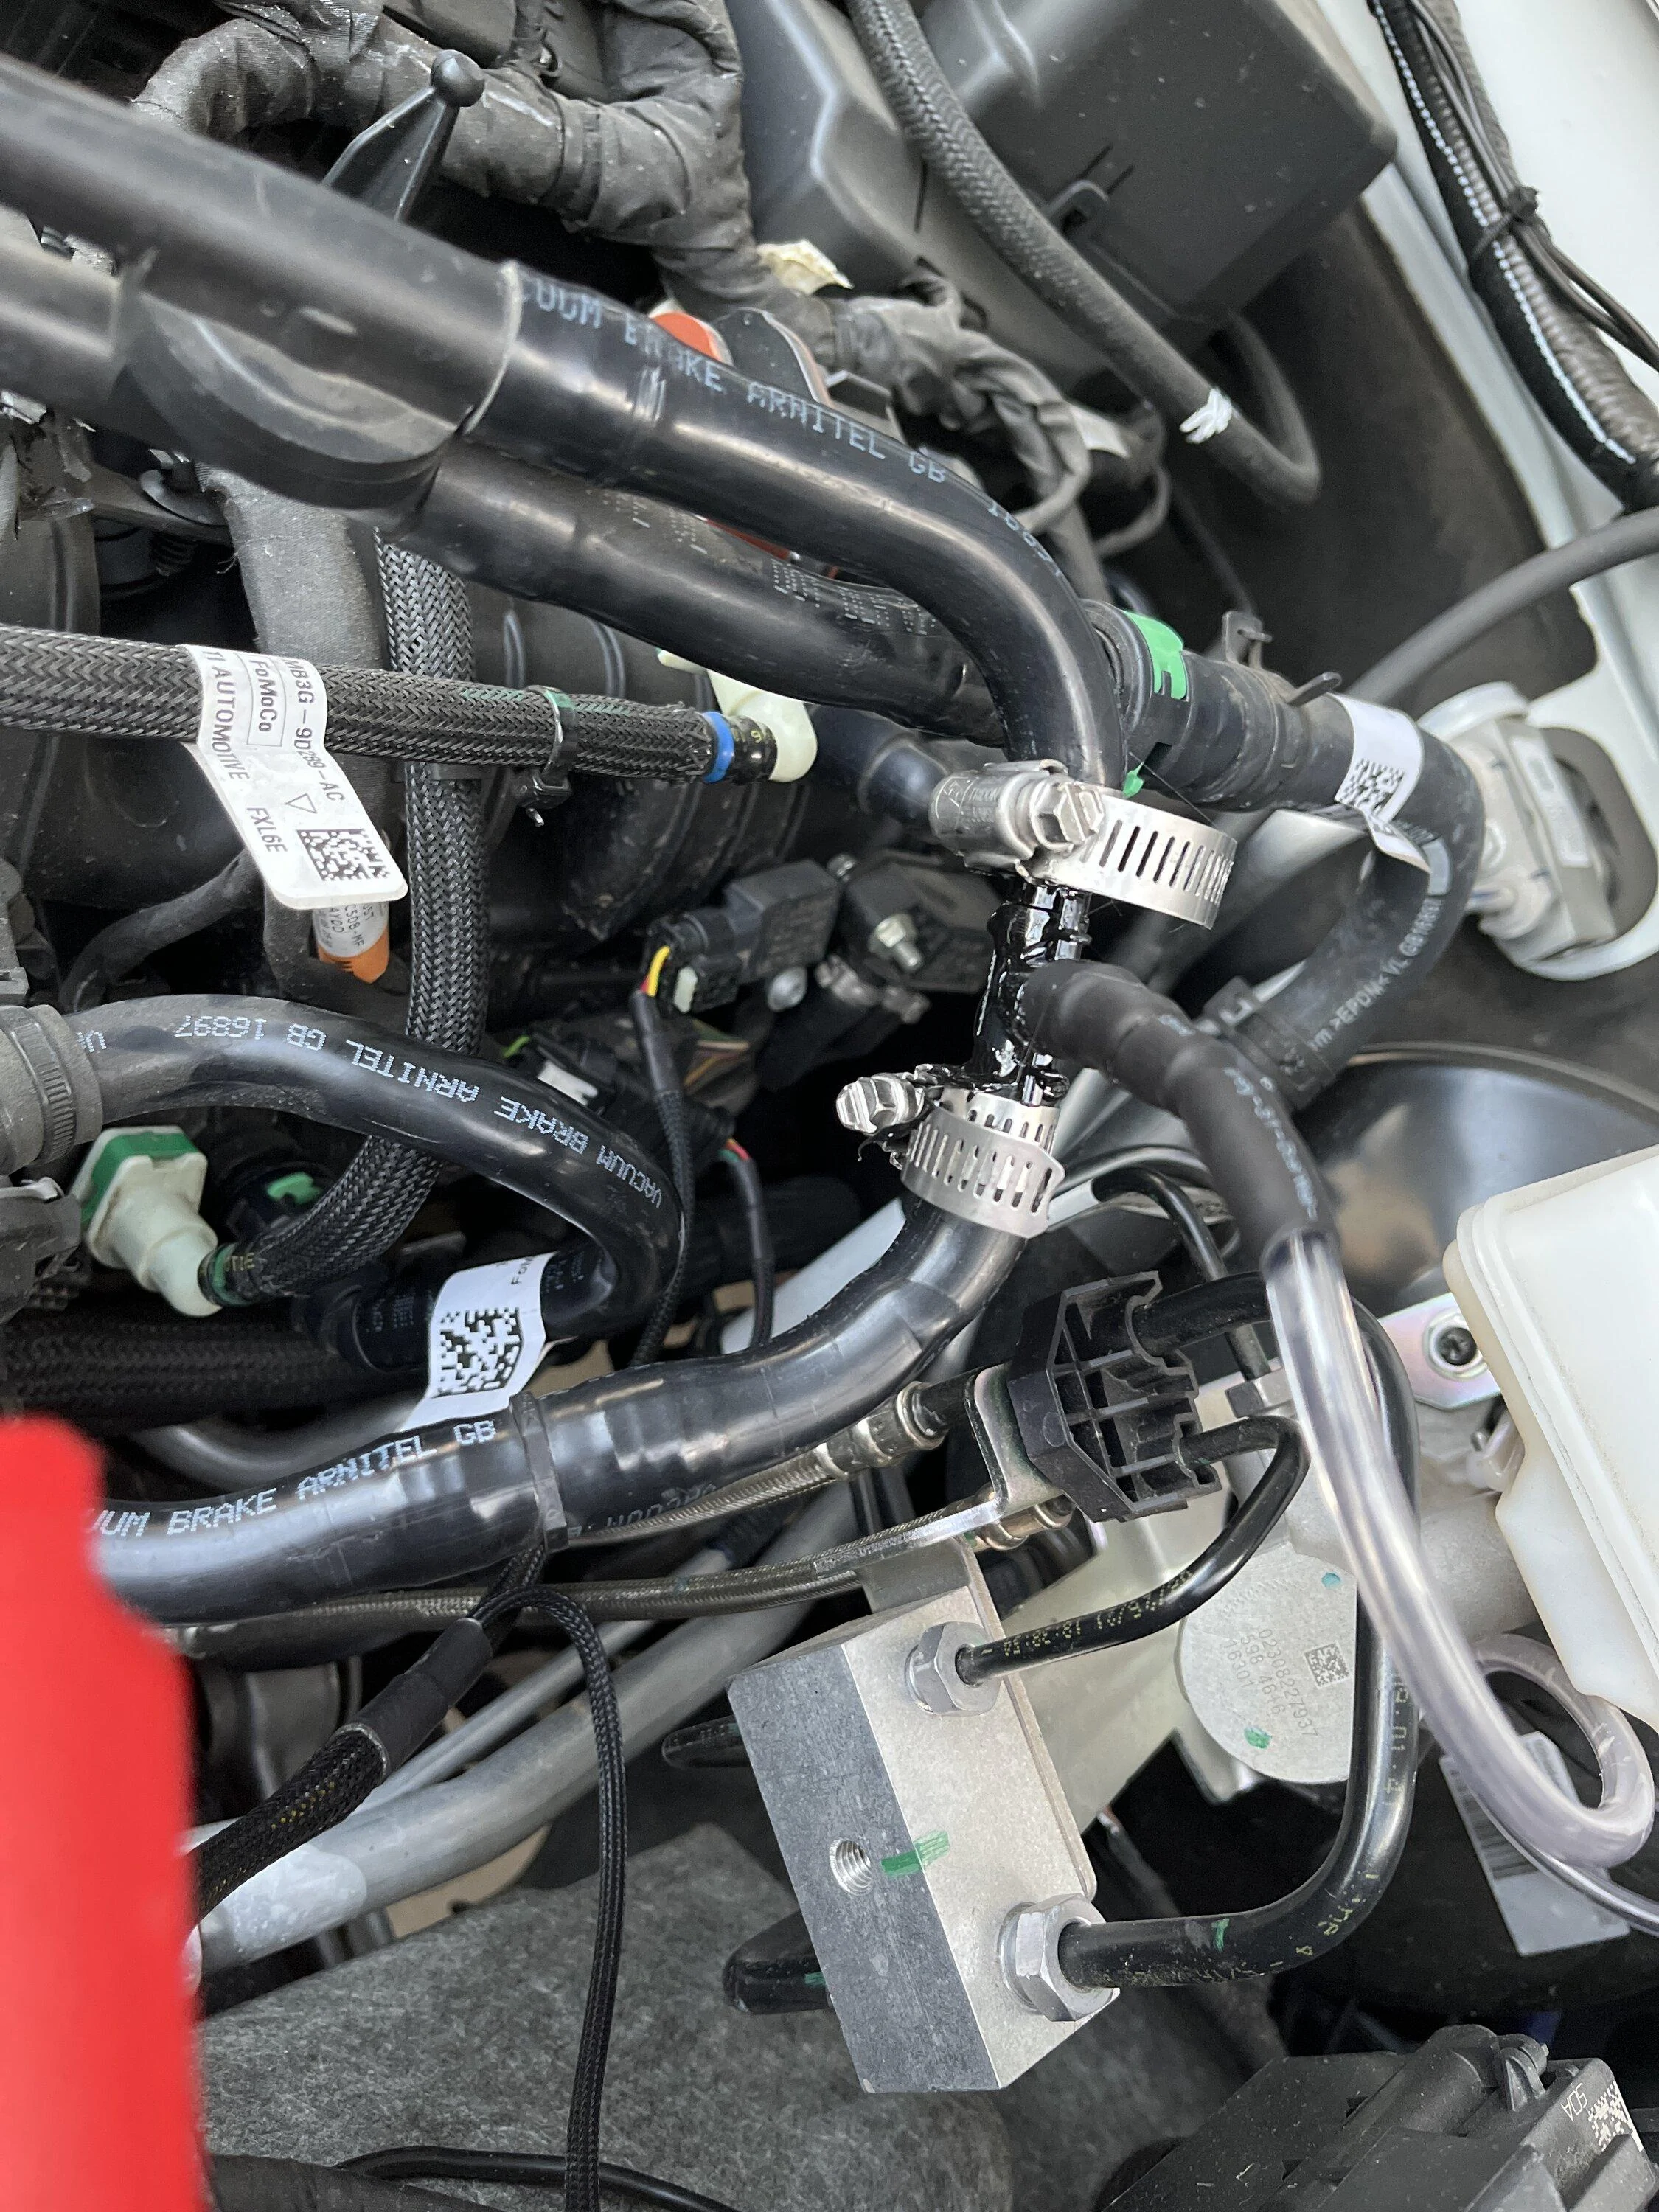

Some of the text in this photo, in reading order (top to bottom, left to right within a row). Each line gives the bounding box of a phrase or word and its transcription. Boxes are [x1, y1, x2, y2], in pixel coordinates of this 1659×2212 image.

[211, 666, 251, 780] AUTOMOTIVE
[248, 658, 278, 732] FoMoCo
[246, 807, 288, 853] FXL6E
[174, 1015, 268, 1040] 16897
[286, 1023, 327, 1051] GB
[345, 1040, 480, 1102] ARNITEL
[493, 1096, 590, 1155] BRAKE
[596, 1145, 663, 1208] VACUUM
[167, 1487, 279, 1537] BRAKE
[296, 1434, 437, 1500] ARNITEL
[454, 1418, 498, 1447] GB
[1240, 1634, 1264, 1665] 598
